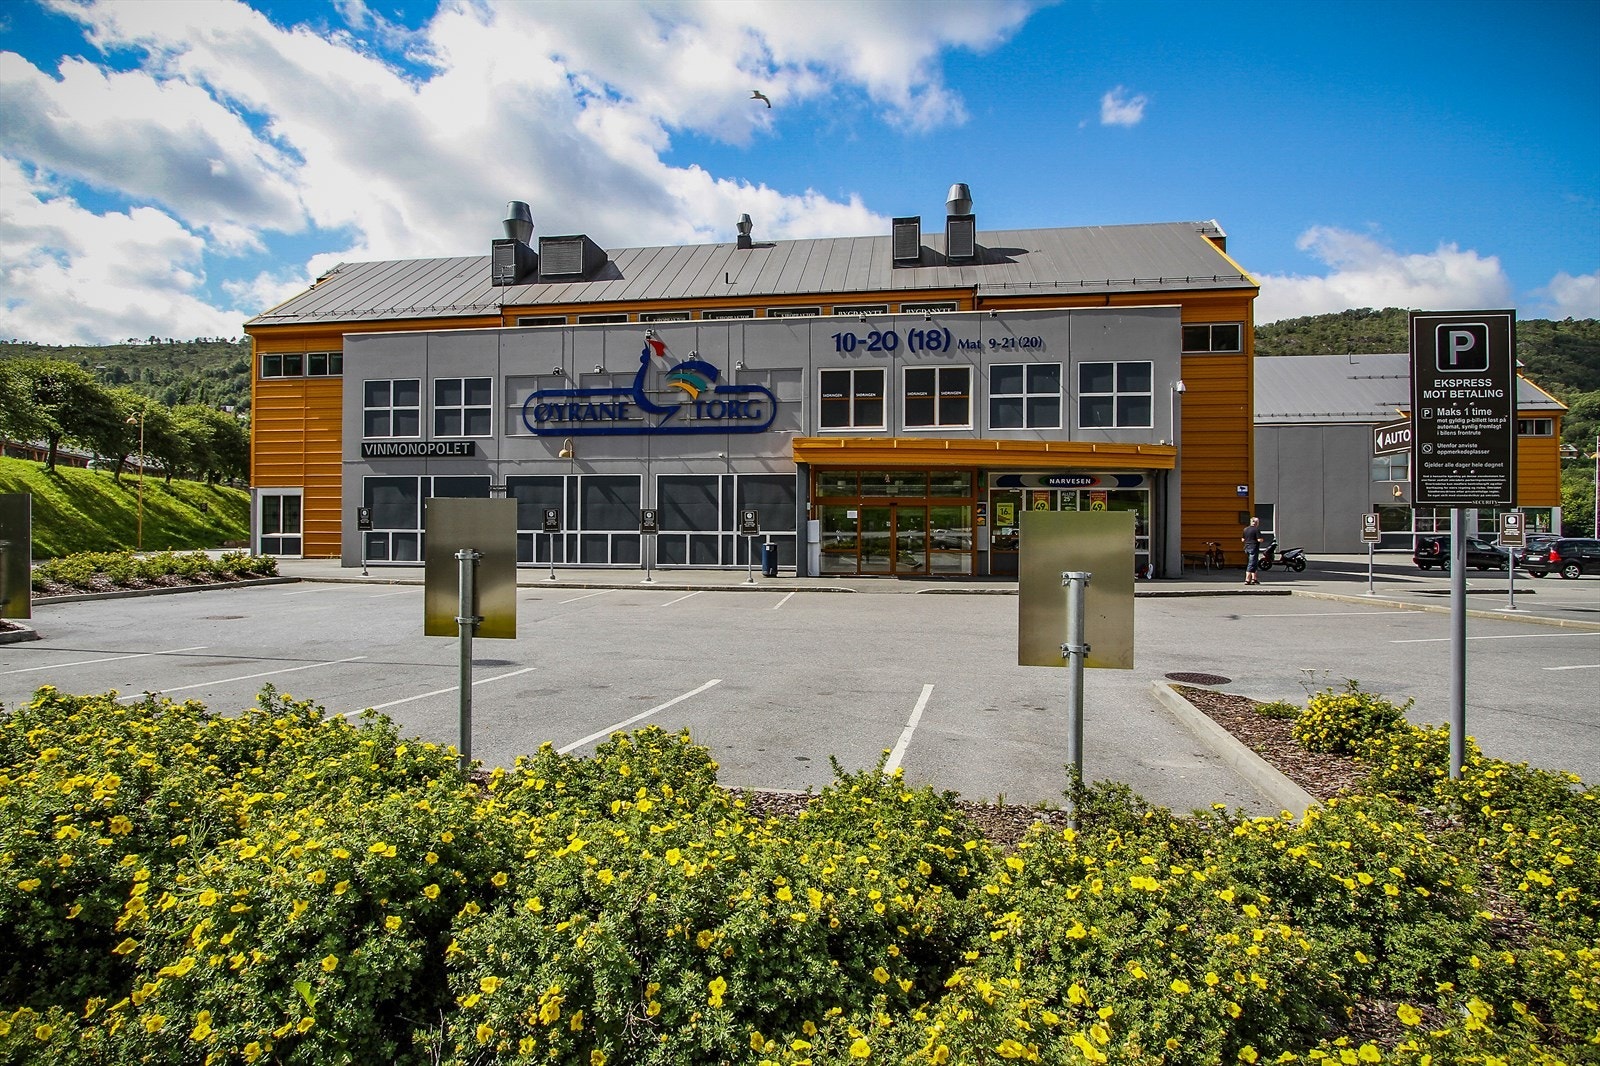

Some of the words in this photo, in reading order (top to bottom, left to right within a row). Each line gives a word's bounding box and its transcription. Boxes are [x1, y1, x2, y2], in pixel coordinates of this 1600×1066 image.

[831, 330, 899, 353] 10-20
[907, 328, 951, 353] (18)
[957, 338, 982, 350] Mat
[988, 337, 1016, 349] 9-21
[1018, 336, 1043, 349] (20)
[1449, 330, 1475, 365] P
[1434, 378, 1493, 388] EKSPRESS
[1423, 390, 1447, 399] MOT
[1449, 389, 1504, 398] BETALING
[533, 401, 630, 423] ØYRANE
[693, 400, 762, 420] TORG
[1423, 409, 1430, 417] P
[1437, 407, 1462, 416] Maks
[1464, 407, 1469, 416] 1
[1472, 407, 1493, 416] time
[364, 442, 470, 456] VINMONOPOLET
